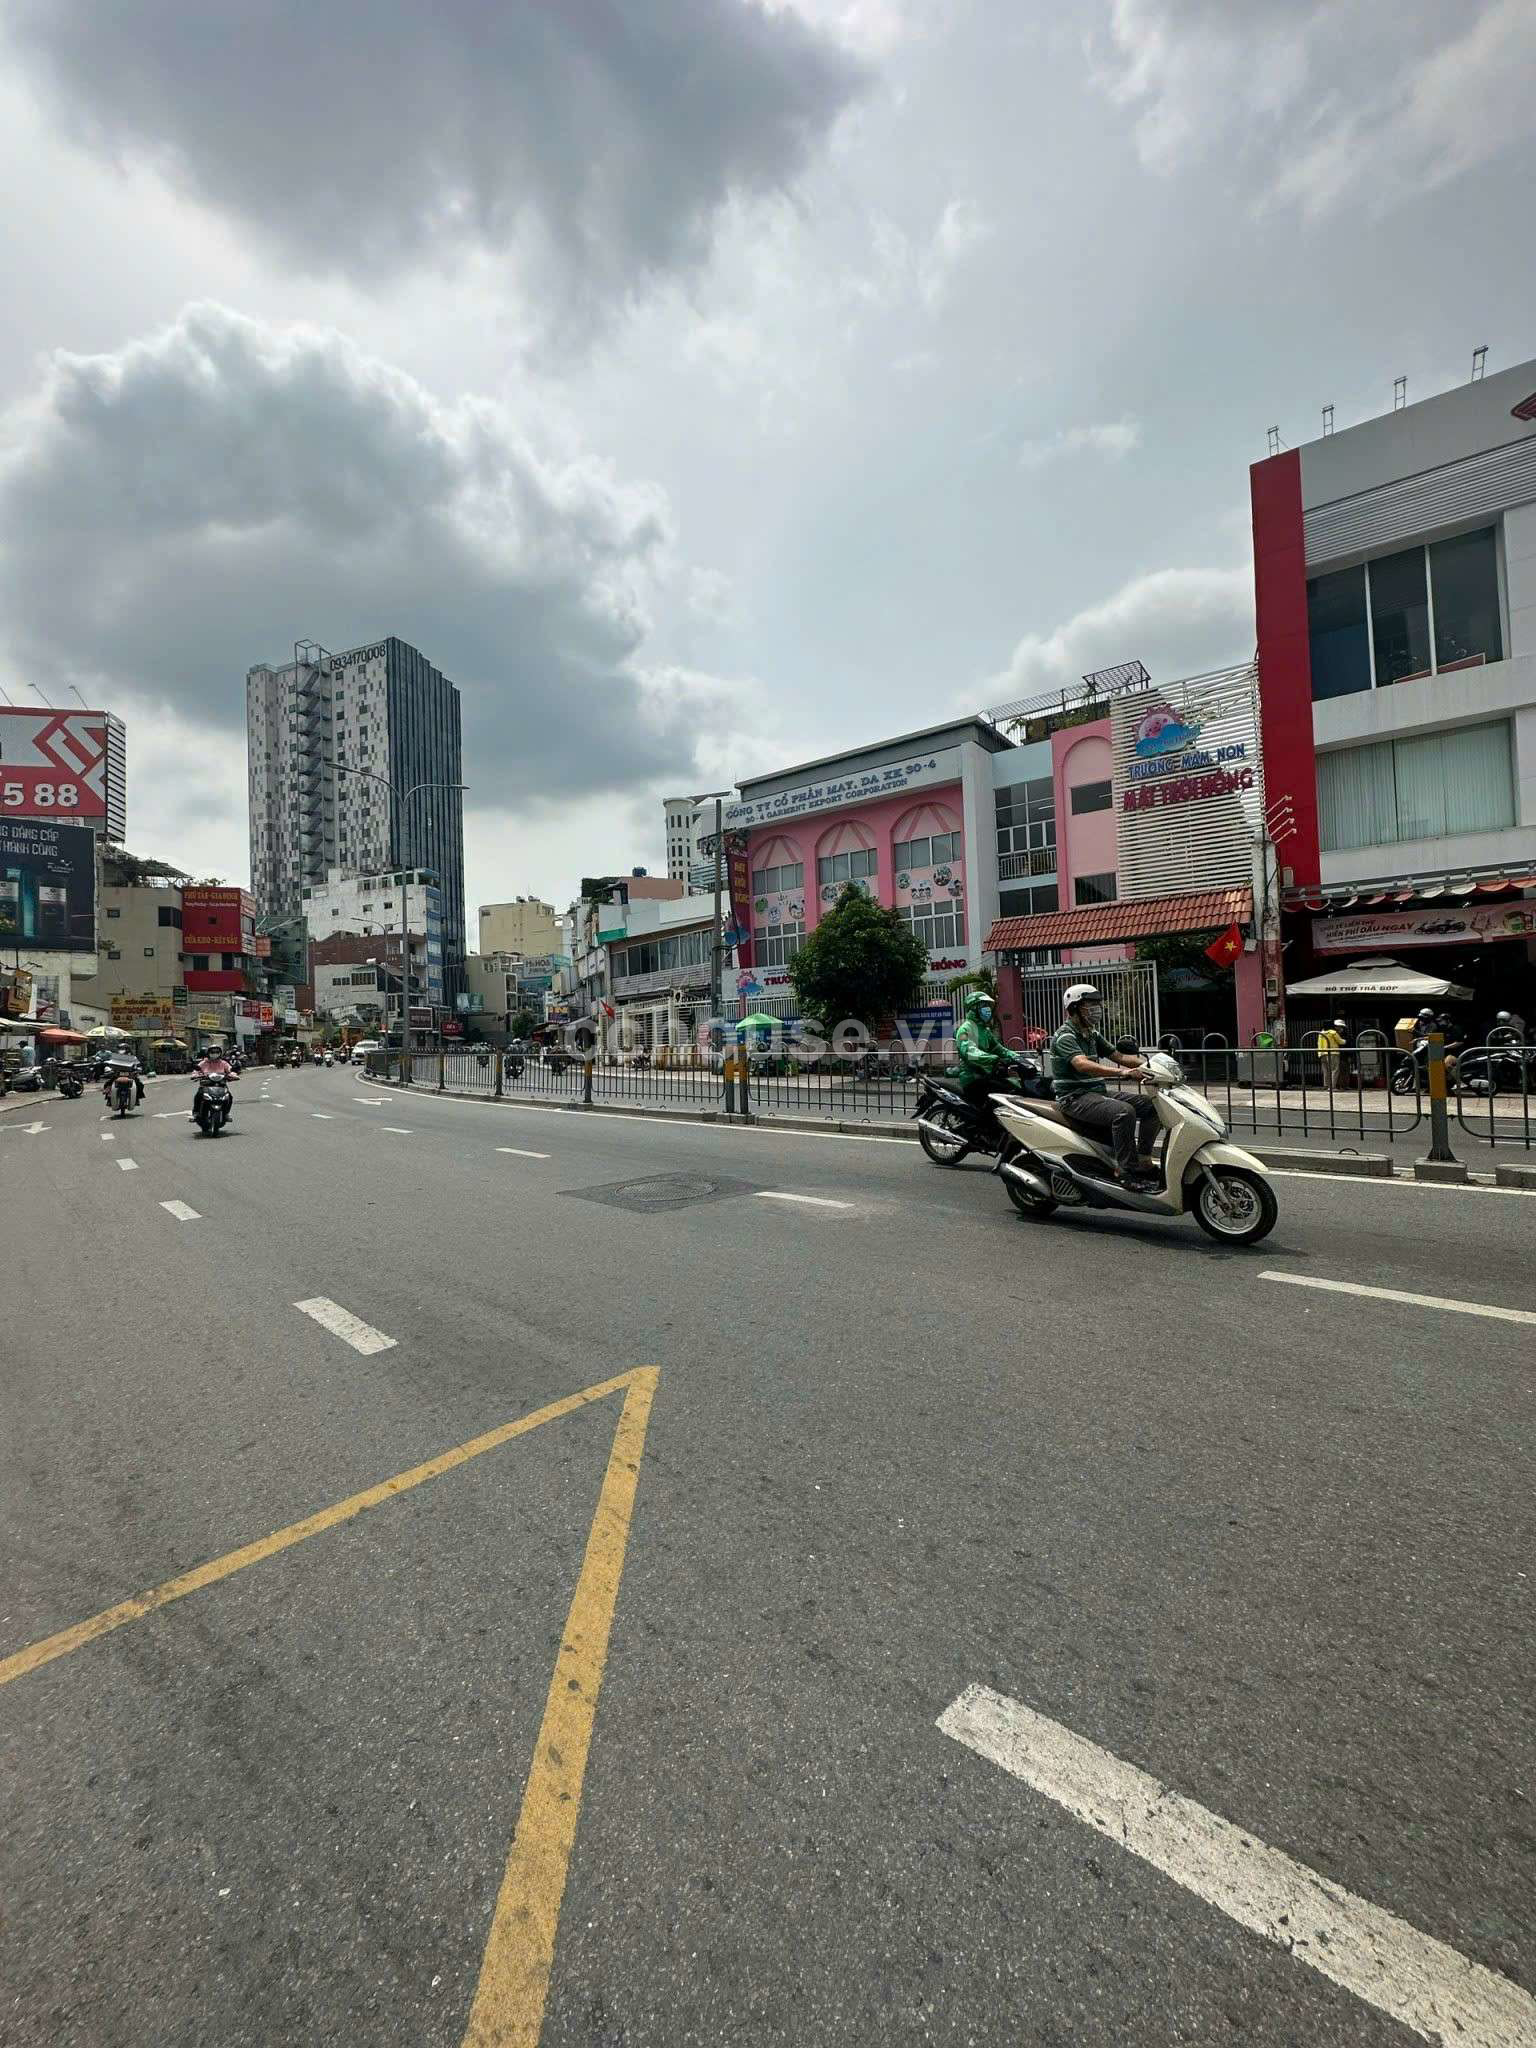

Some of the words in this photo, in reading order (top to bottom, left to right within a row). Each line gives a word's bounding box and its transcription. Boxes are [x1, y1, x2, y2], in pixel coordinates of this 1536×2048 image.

[330, 644, 386, 671] 0934170008
[1217, 743, 1245, 761] NON
[756, 801, 771, 812] TY
[861, 775, 879, 786] DA
[767, 803, 806, 818] GARMENT
[808, 794, 843, 808] EXPORT
[845, 777, 908, 799] CORPORATION
